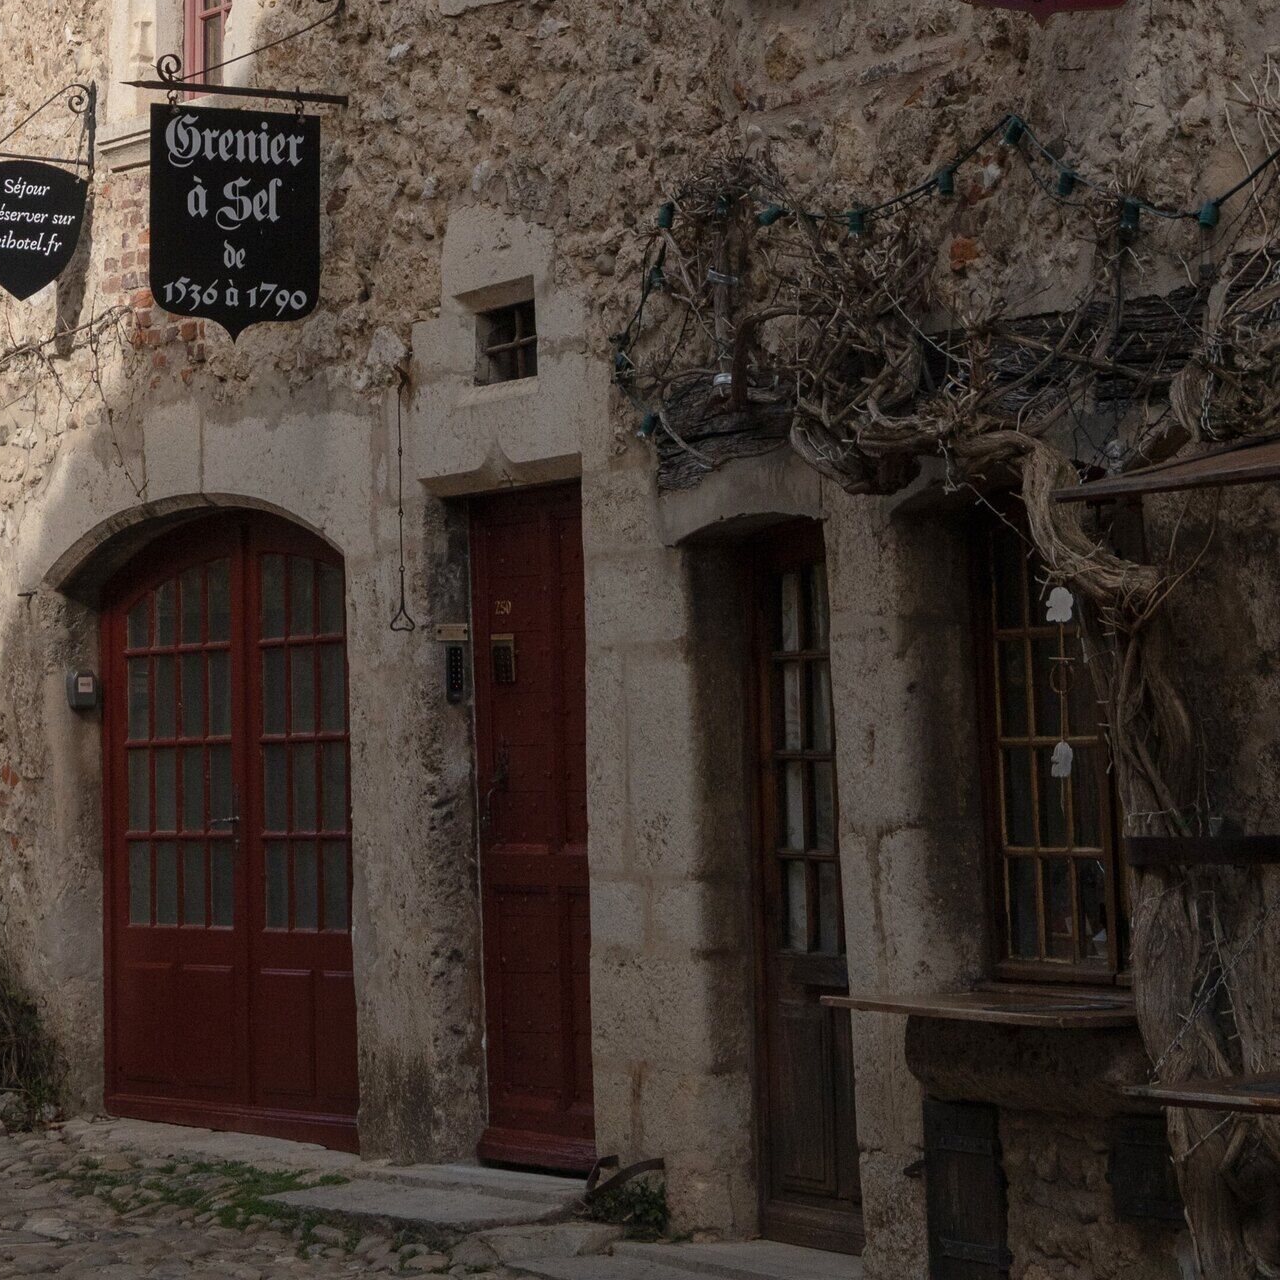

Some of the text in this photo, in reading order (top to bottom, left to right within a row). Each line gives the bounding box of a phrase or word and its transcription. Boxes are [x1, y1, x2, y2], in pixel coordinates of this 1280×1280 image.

[165, 113, 305, 168] Grenier
[4, 177, 50, 198] Séjour
[187, 175, 283, 231] à Sel
[52, 214, 75, 226] sur
[223, 240, 246, 269] de
[163, 276, 307, 317] 1536 à 1790
[495, 600, 512, 615] 250
